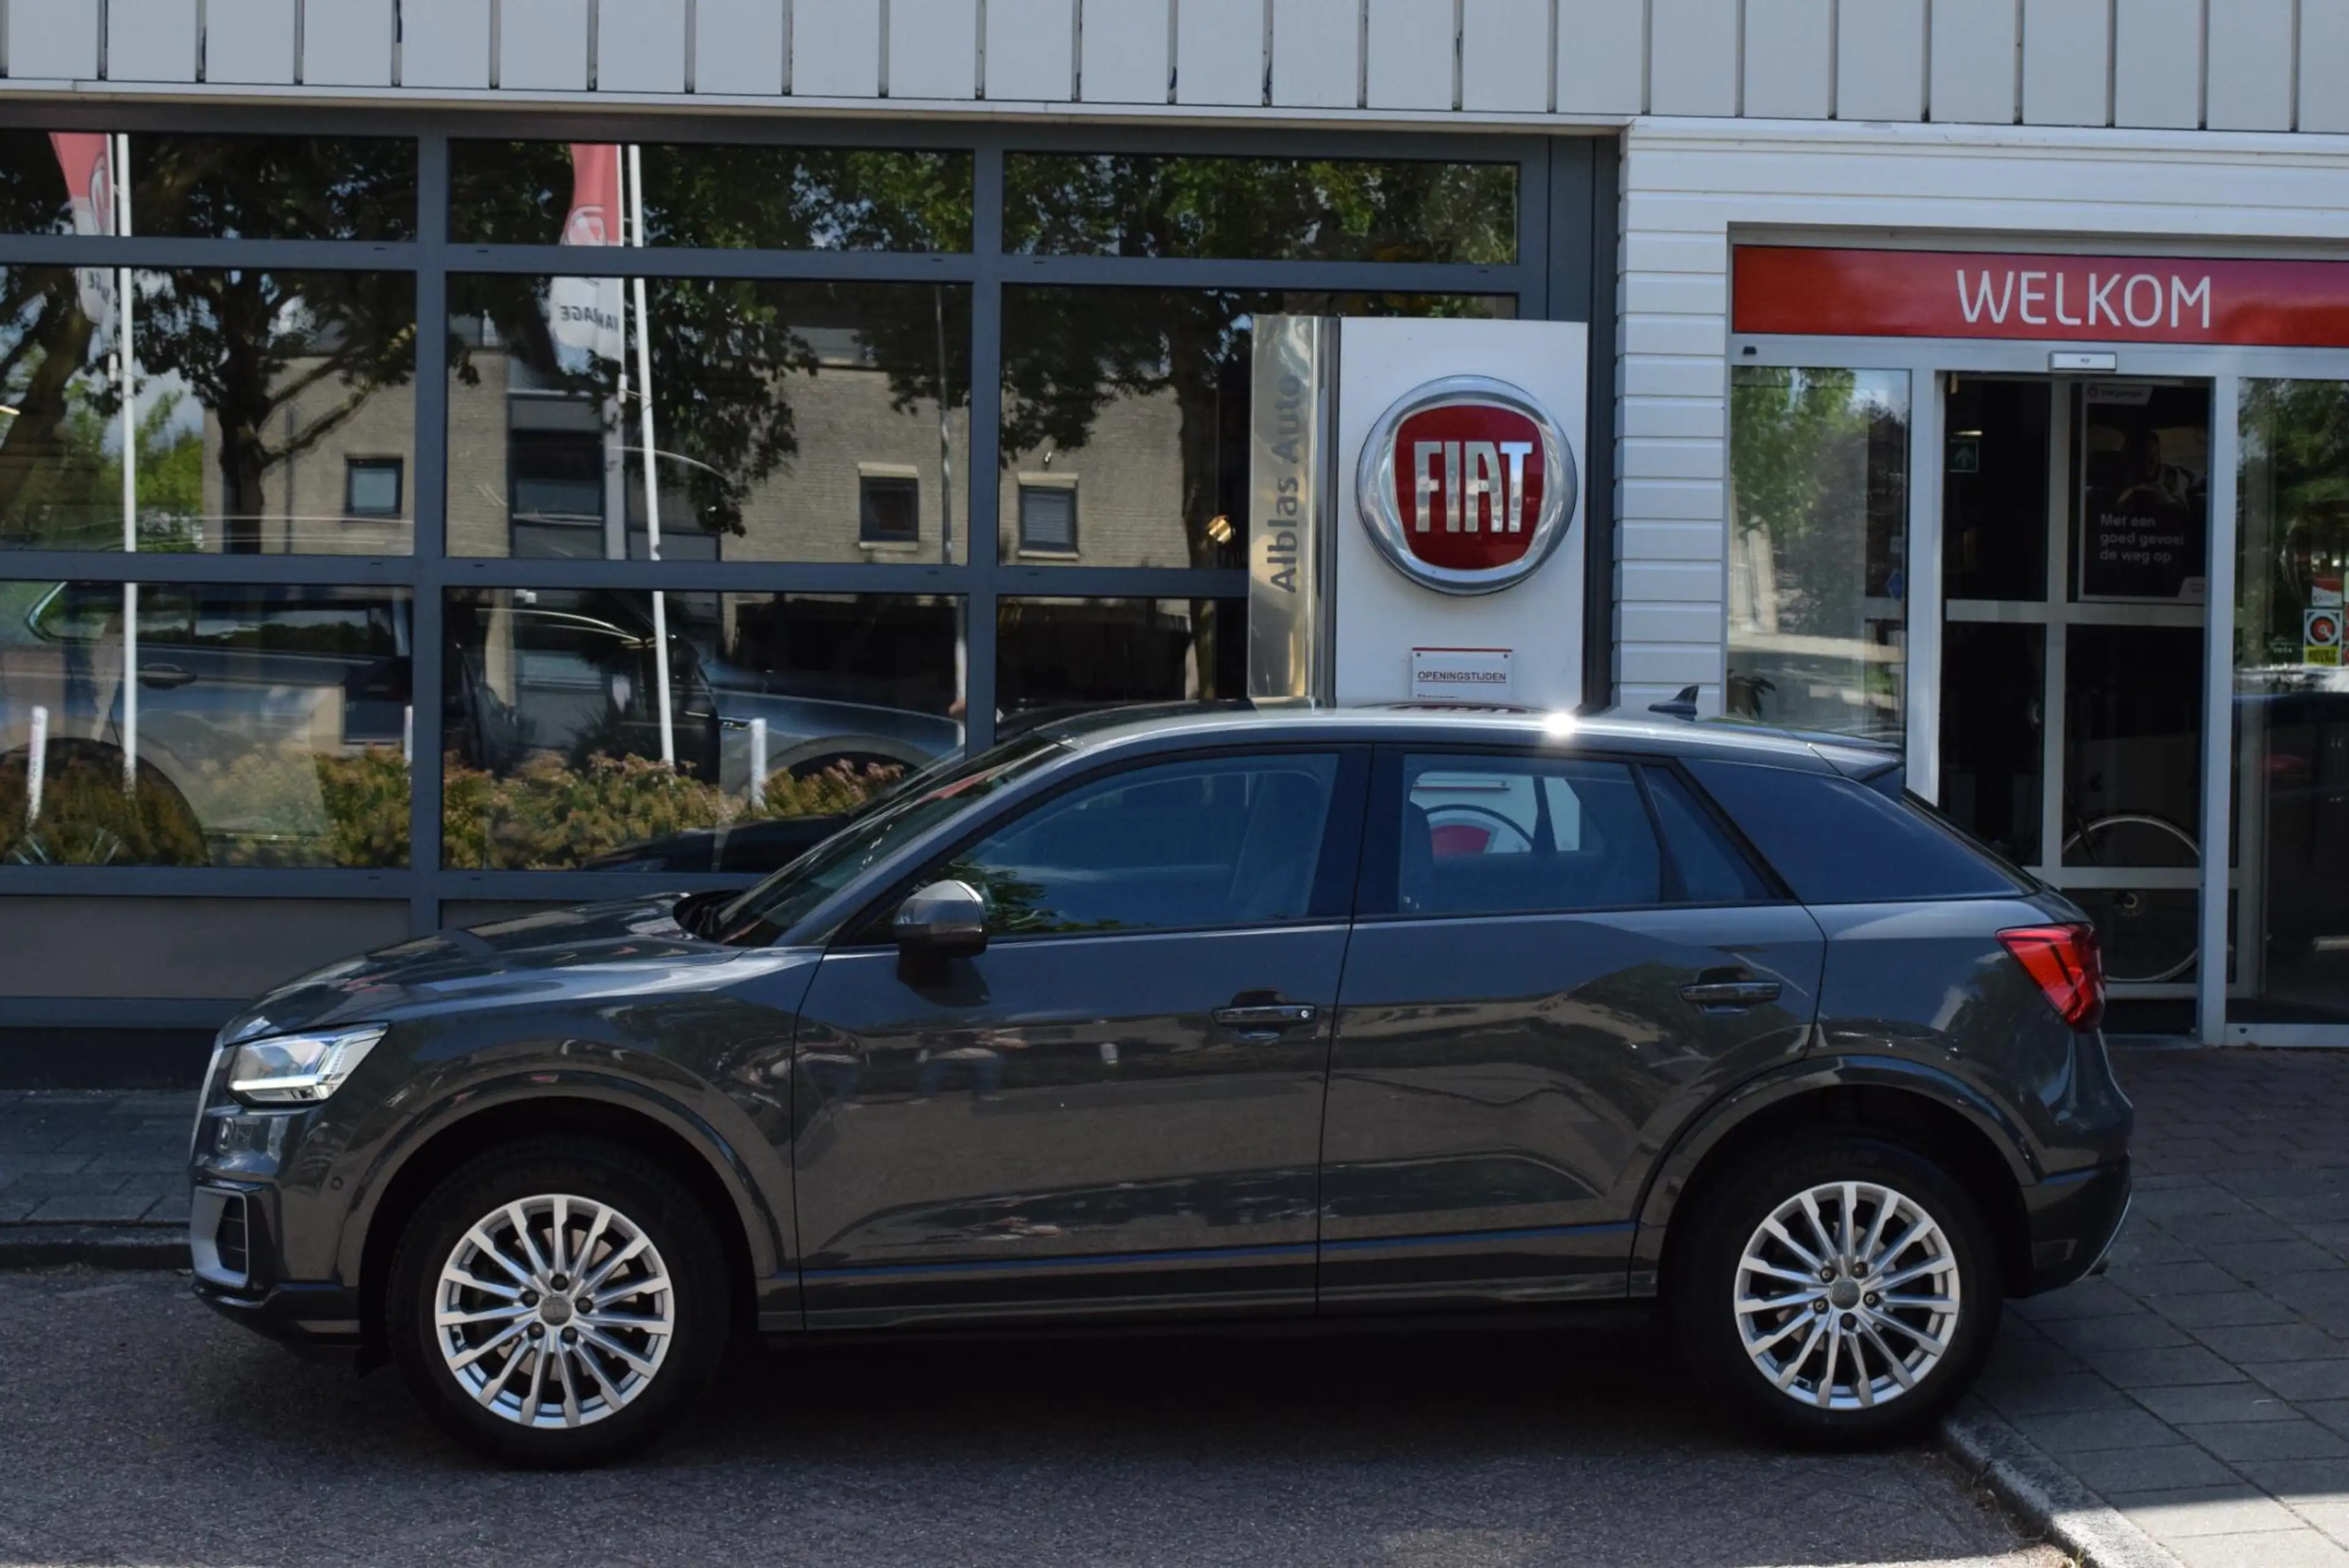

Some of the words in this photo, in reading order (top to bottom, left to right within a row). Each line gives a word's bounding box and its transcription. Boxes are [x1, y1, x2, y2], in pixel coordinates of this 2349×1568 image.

[1957, 270, 2210, 329] WELKOM
[1271, 373, 1300, 463] Auto
[1414, 441, 1532, 532] FIAT
[1267, 476, 1298, 593] Alblas
[2100, 513, 2127, 526] Met
[2130, 516, 2156, 527] een
[2099, 549, 2117, 561] de
[2121, 552, 2150, 565] weg
[2153, 552, 2172, 564] op
[2100, 532, 2136, 546] goed
[2139, 533, 2184, 548] gevoel
[1417, 671, 1506, 682] OPENINGSTIJDEN
